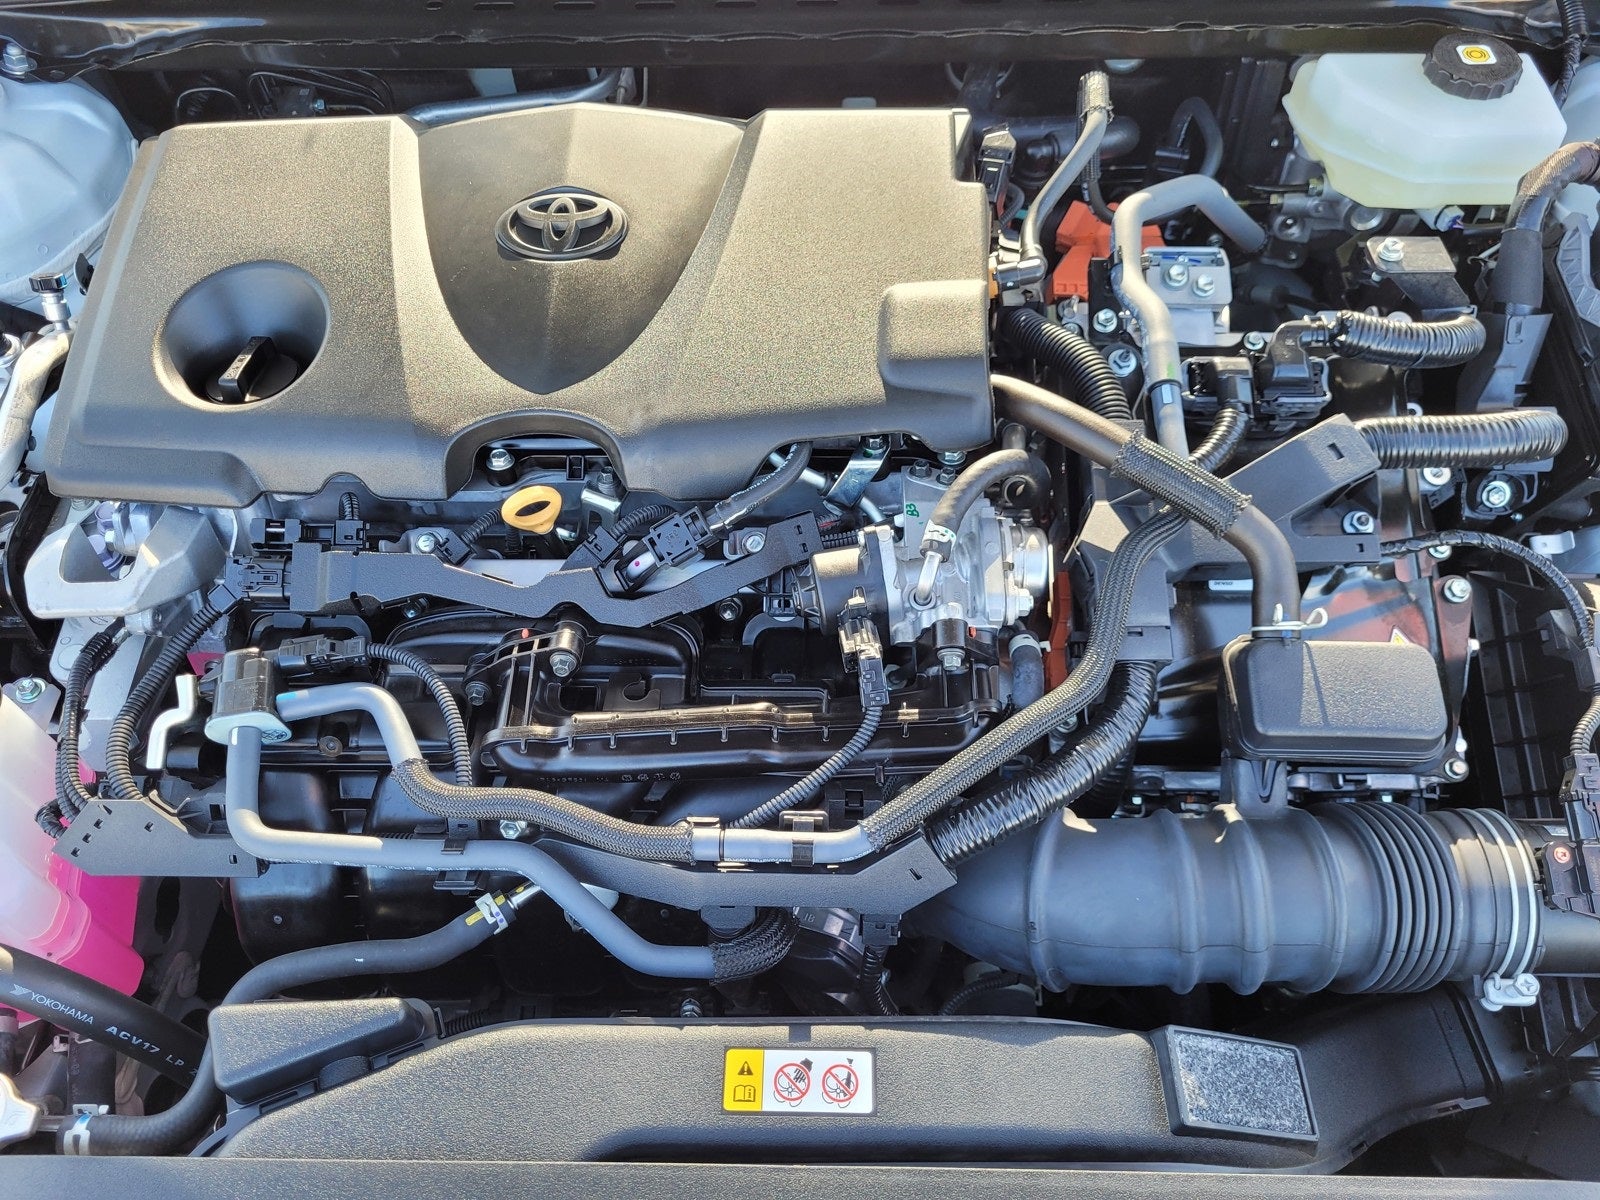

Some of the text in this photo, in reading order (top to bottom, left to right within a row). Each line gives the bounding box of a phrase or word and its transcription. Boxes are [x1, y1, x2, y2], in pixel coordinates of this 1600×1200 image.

[30, 991, 94, 1025] YOKOHAMA
[105, 1026, 160, 1053] ACV17
[165, 1054, 185, 1066] LP
